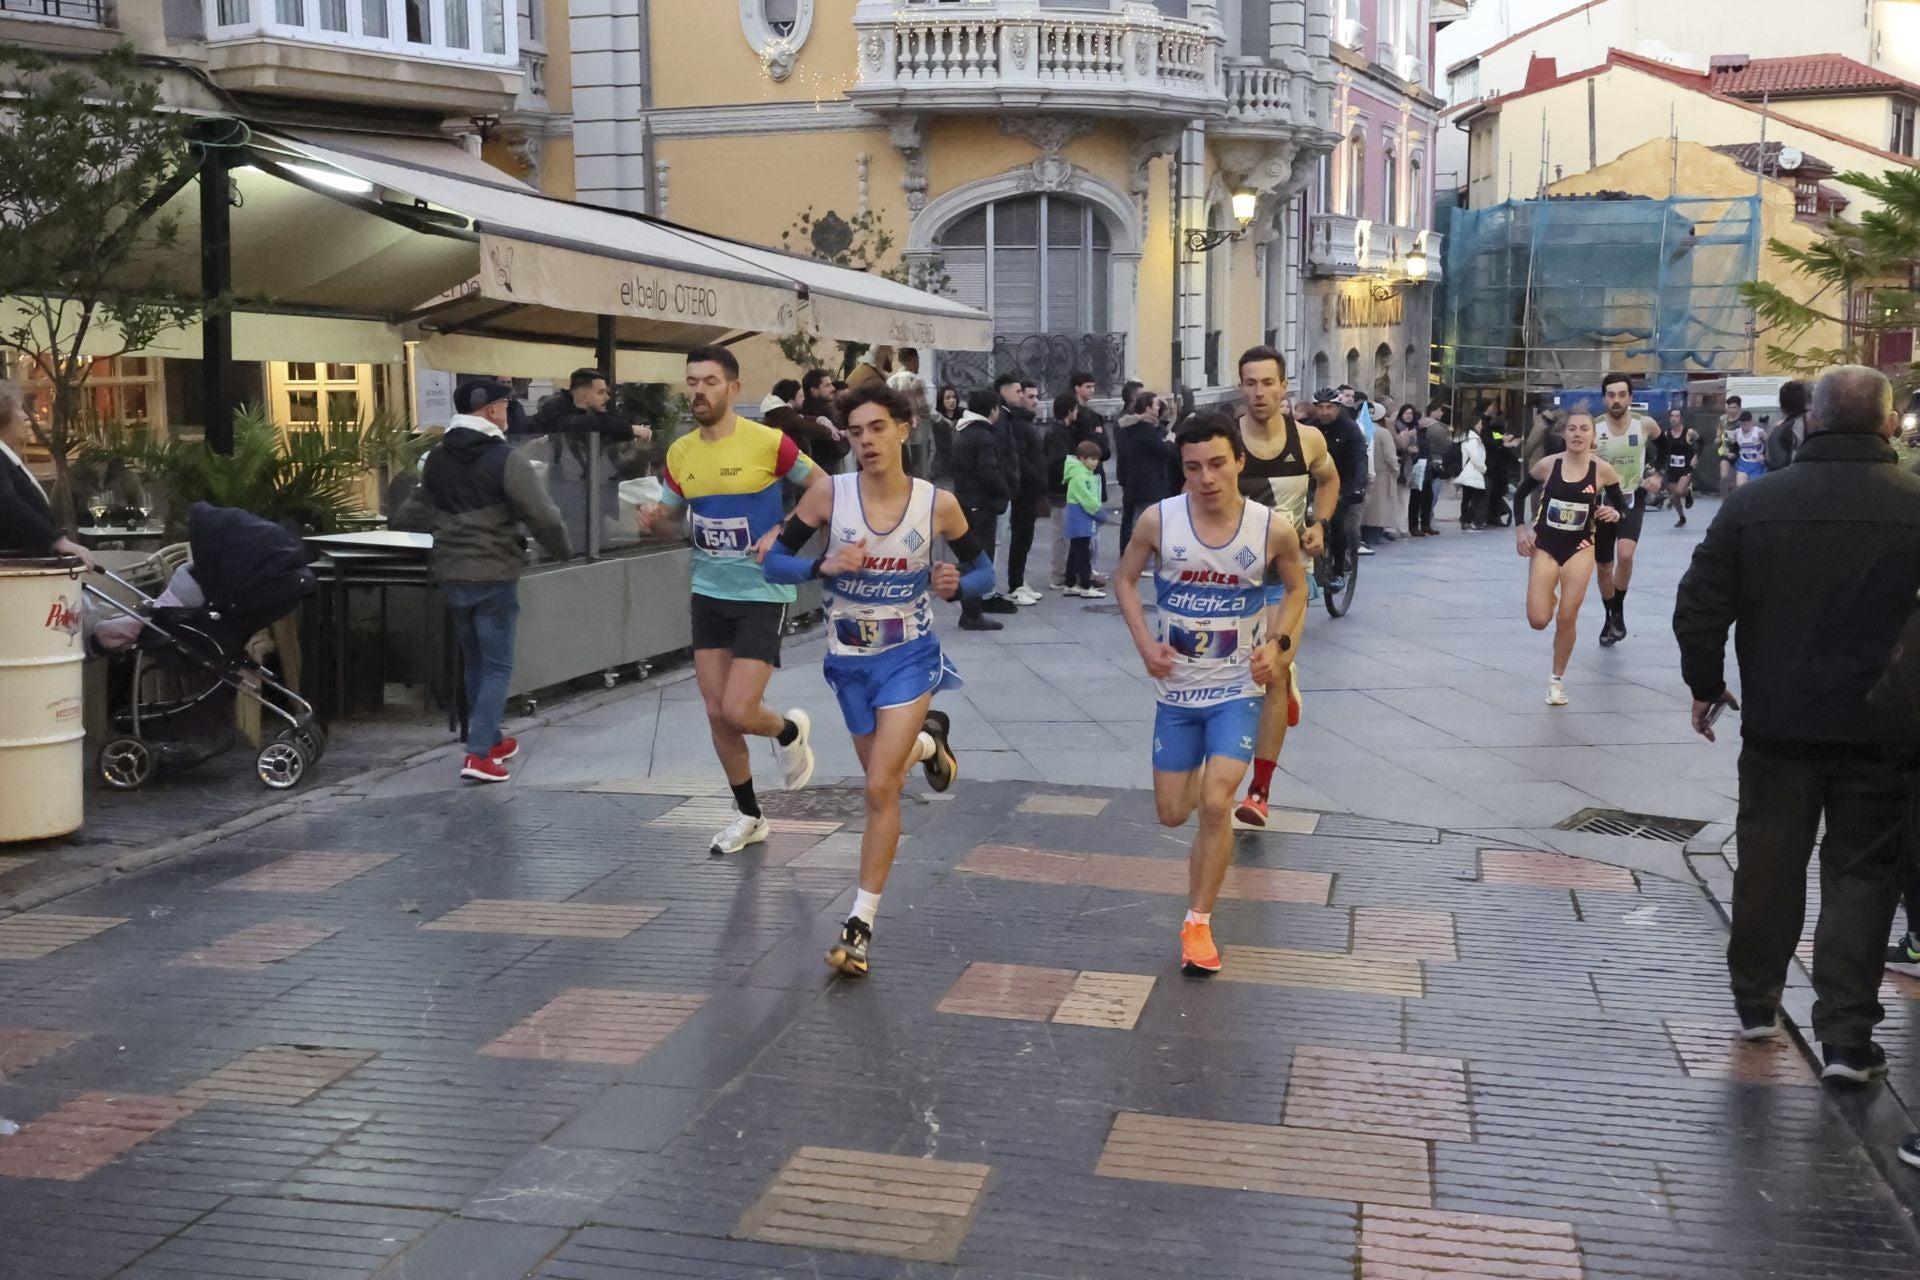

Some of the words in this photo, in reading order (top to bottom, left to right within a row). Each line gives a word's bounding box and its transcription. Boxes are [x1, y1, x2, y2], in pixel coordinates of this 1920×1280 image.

[620, 280, 633, 305] el
[637, 276, 667, 311] bello
[675, 284, 717, 316] OTERO
[1561, 510, 1575, 521] 60
[703, 529, 738, 548] 1541
[857, 620, 880, 643] 13
[1194, 631, 1209, 654] 2
